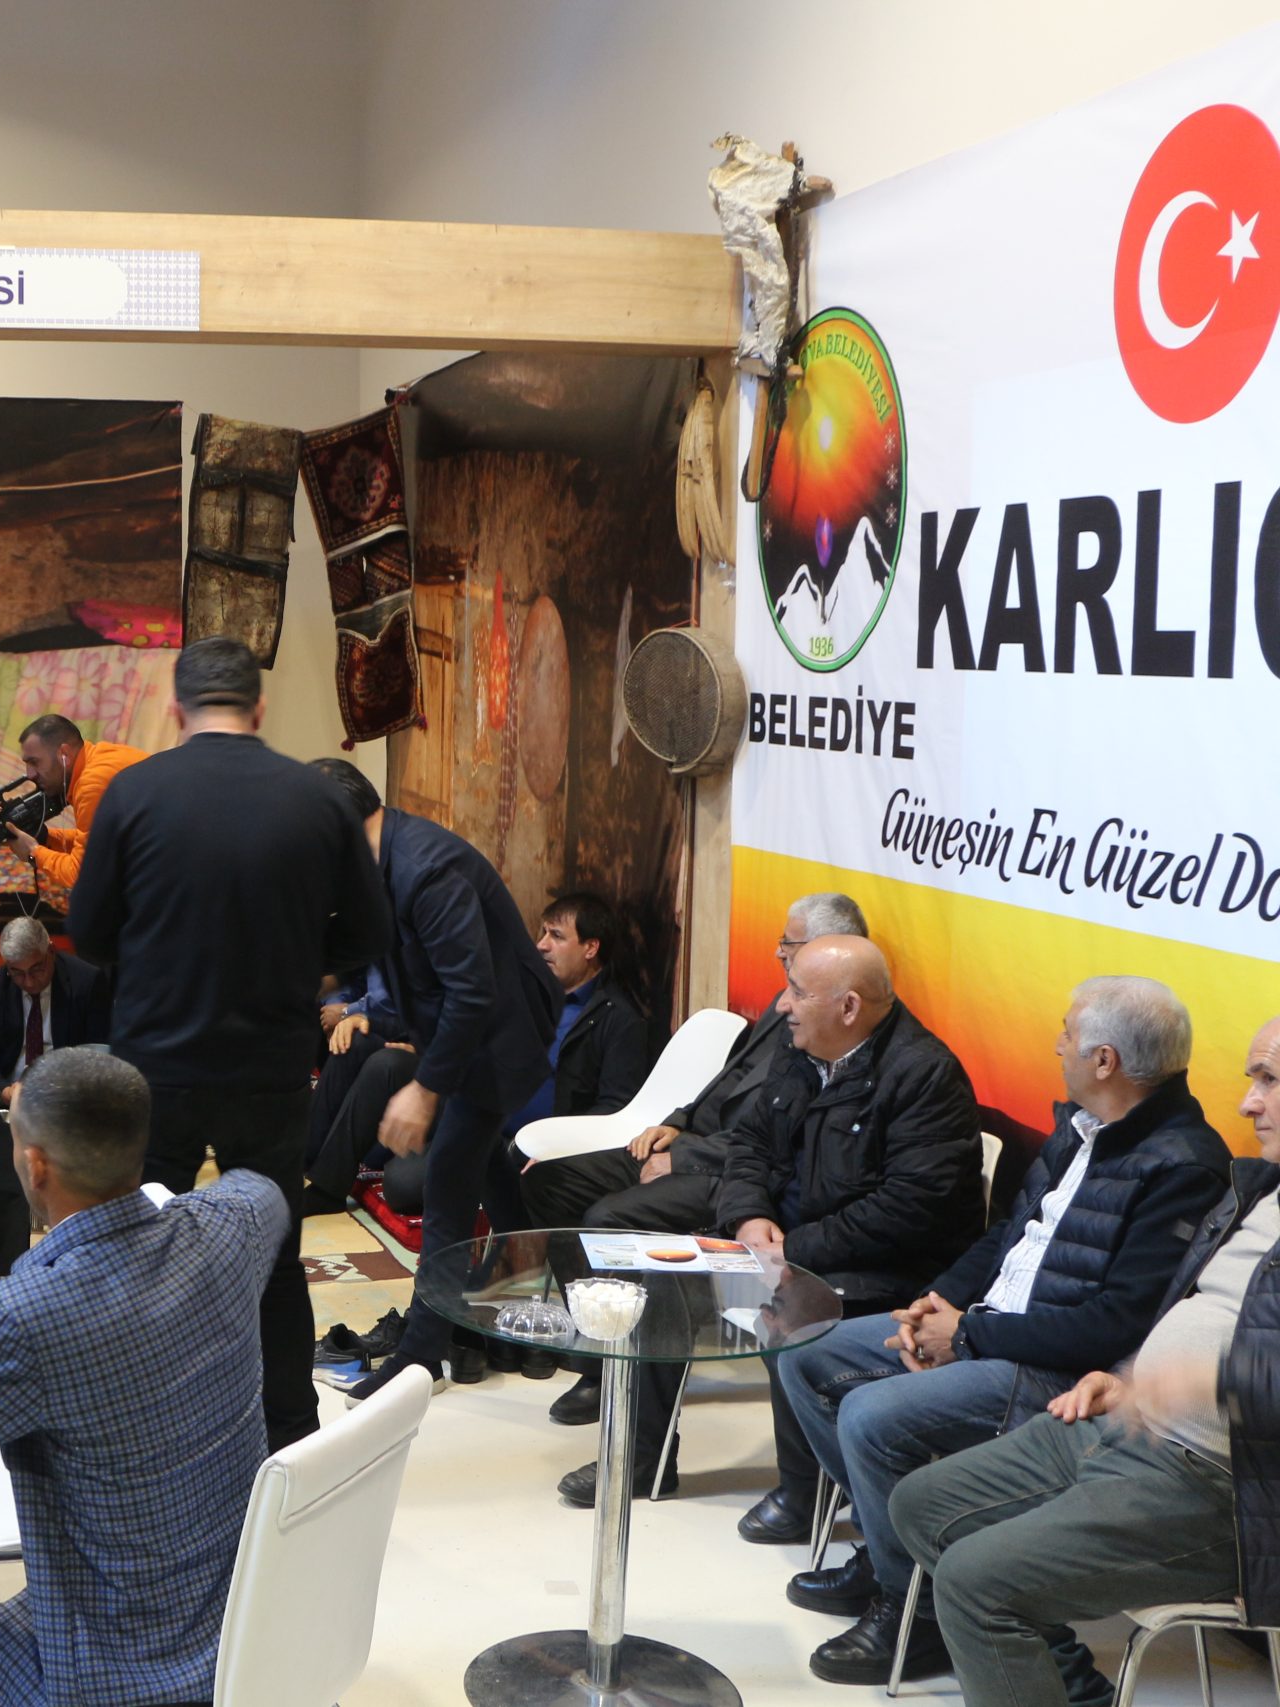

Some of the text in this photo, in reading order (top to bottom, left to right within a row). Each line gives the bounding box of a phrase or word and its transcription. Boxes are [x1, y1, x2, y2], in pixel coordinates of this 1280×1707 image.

[917, 480, 1280, 680] KARLI
[810, 636, 835, 657] 1936
[749, 684, 916, 760] BELEDİYE
[881, 788, 1014, 882] Güneşin
[1018, 808, 1076, 894] En
[1084, 817, 1224, 908] Güzel
